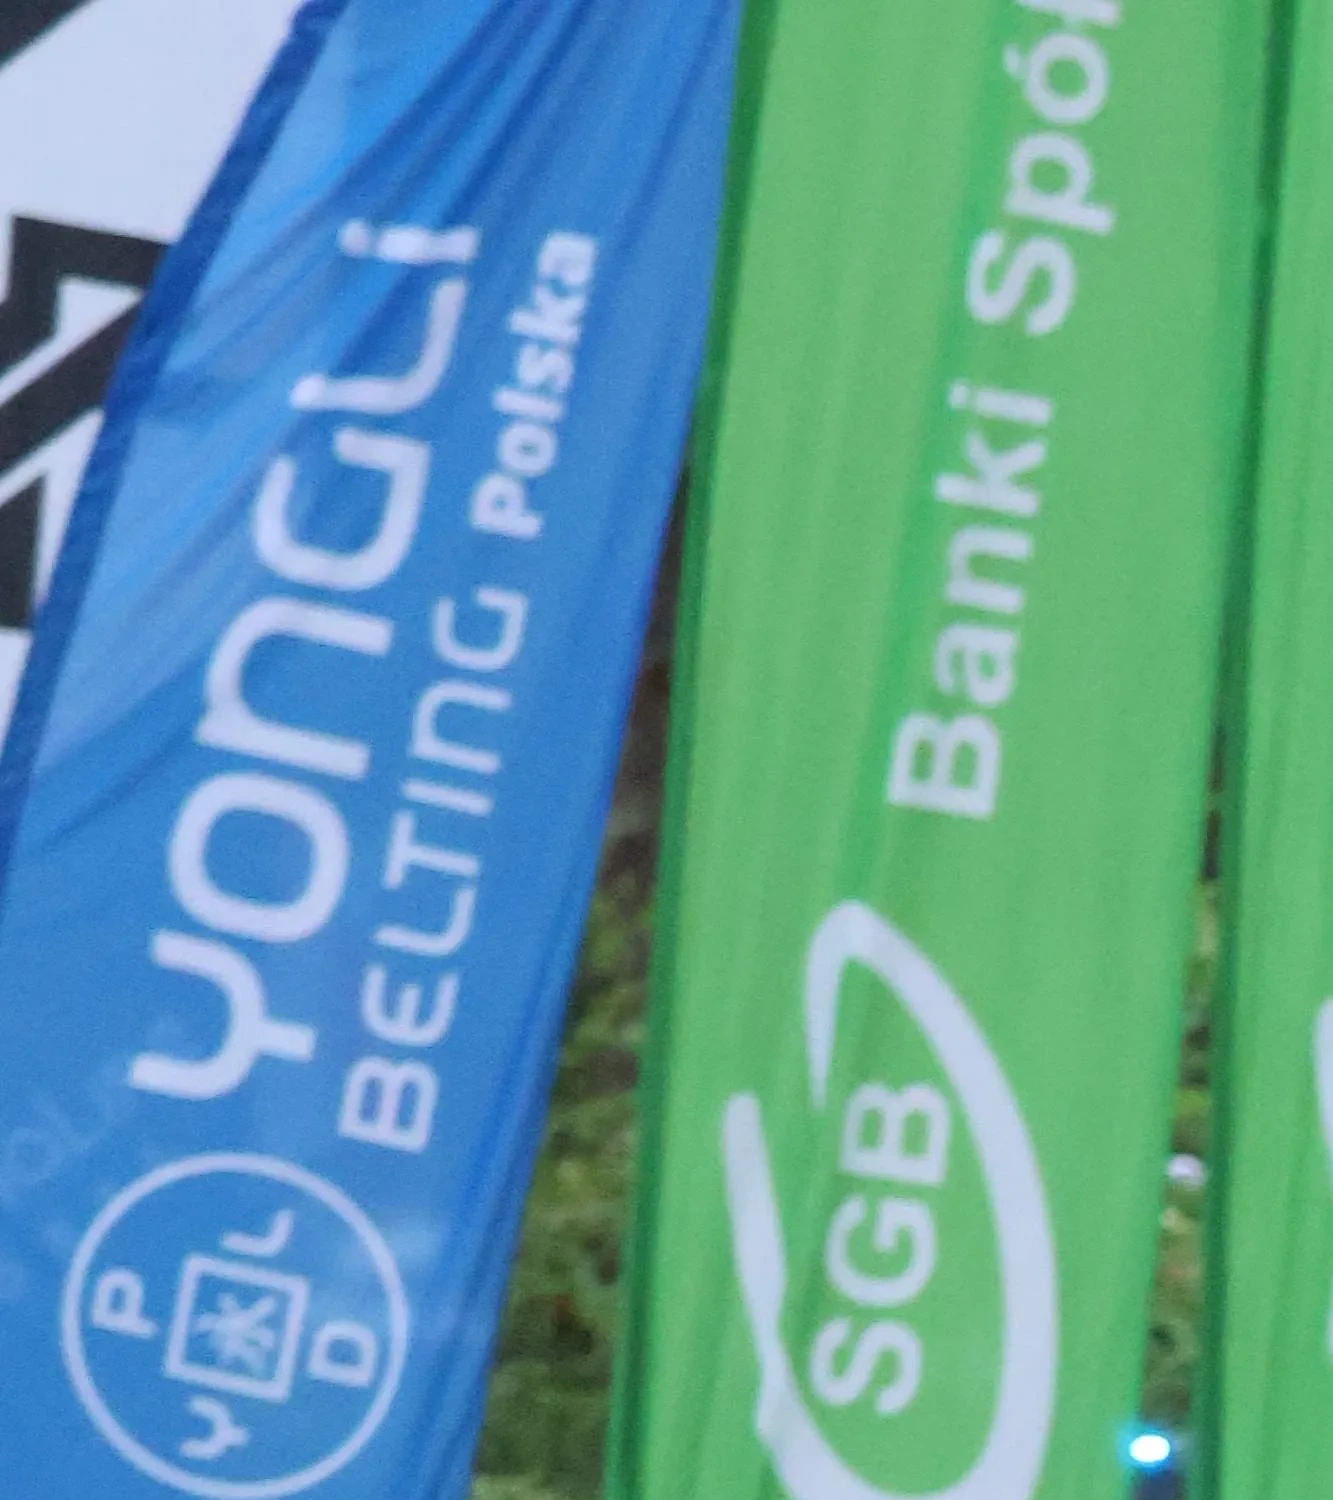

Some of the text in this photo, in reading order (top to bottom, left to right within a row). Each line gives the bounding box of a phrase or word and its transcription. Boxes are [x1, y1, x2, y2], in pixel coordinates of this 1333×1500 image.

[338, 231, 598, 1153] BELTING Polska
[887, 380, 1053, 821] Banki
[810, 1080, 952, 1416] SGB
